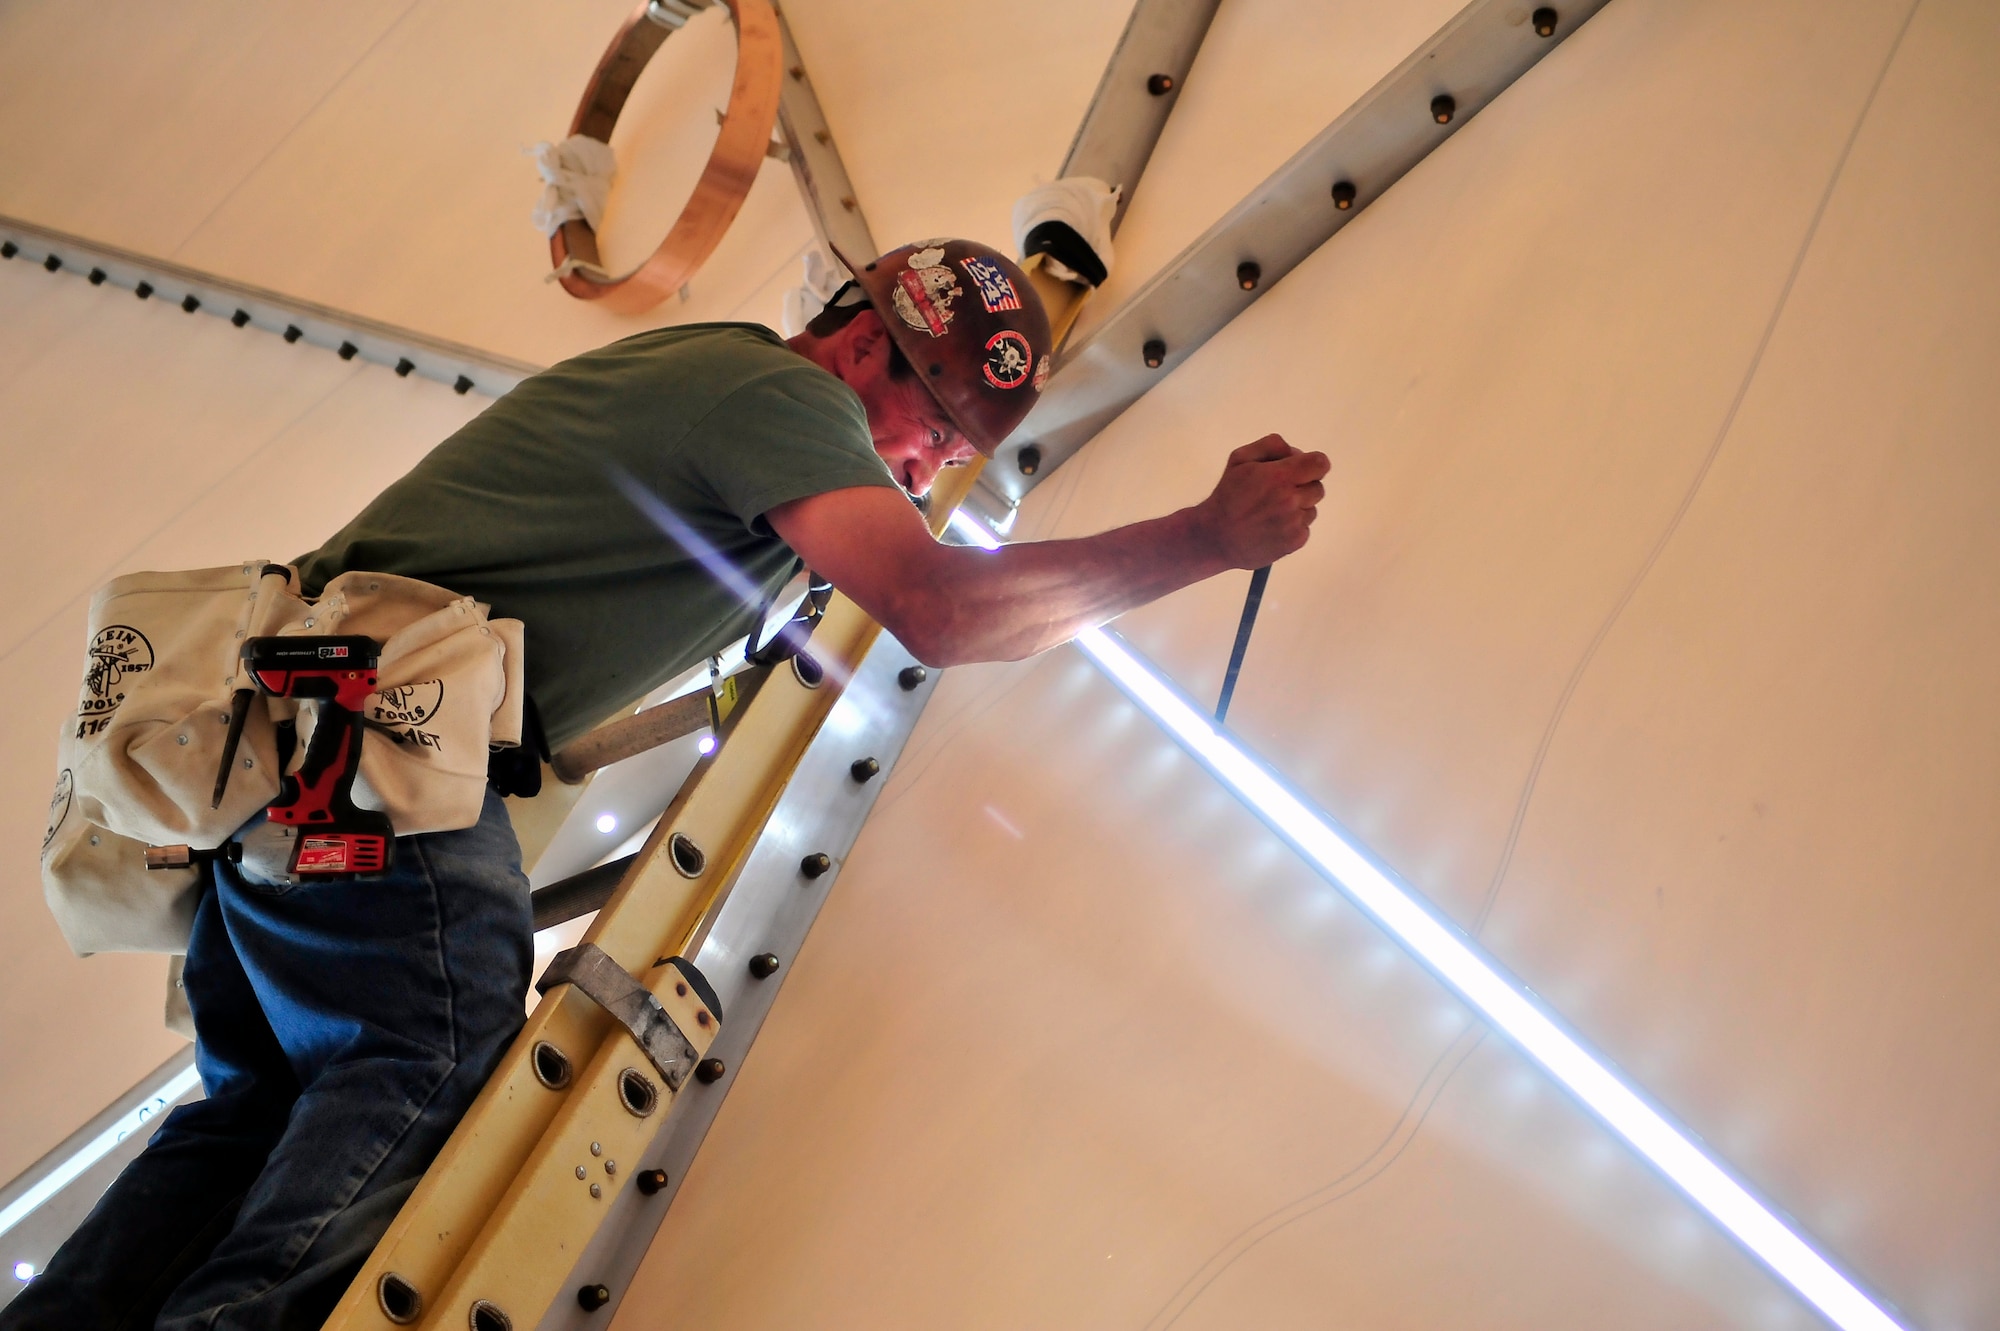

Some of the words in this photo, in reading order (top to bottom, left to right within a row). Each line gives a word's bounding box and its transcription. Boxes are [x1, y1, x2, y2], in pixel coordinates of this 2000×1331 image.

[969, 262, 1002, 303] 24
[97, 630, 136, 645] LEIN
[320, 646, 348, 659] M18
[121, 663, 150, 673] 1857
[374, 705, 425, 721] TOOLS
